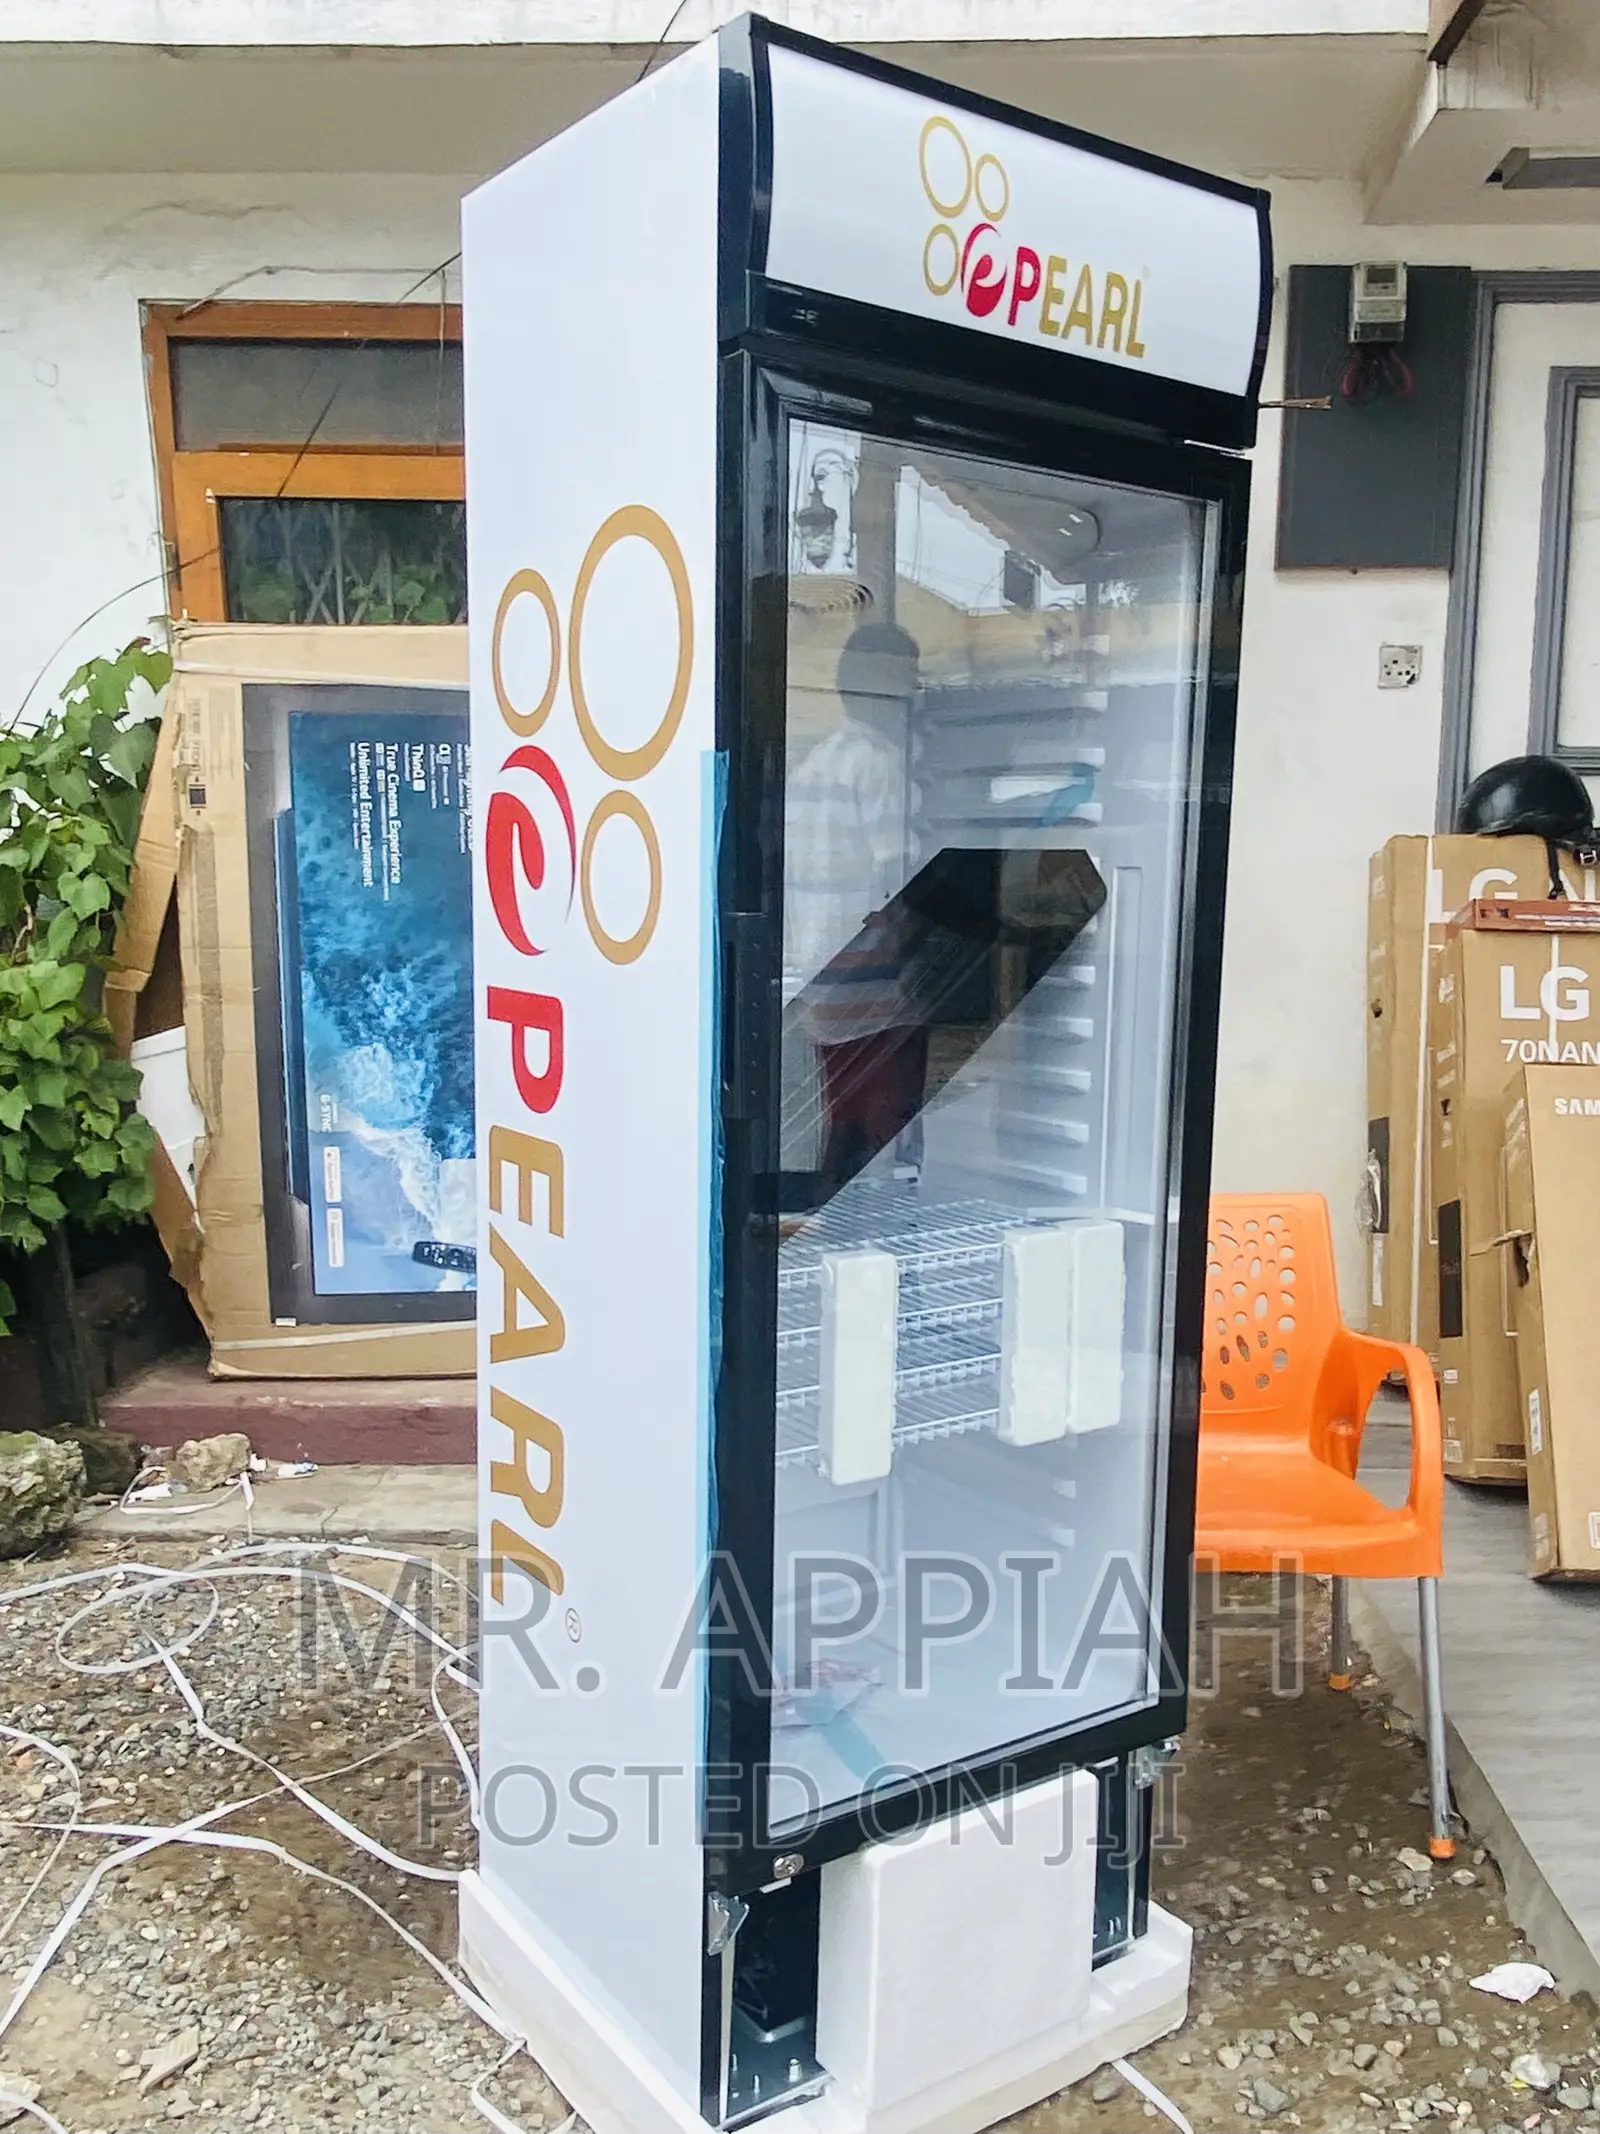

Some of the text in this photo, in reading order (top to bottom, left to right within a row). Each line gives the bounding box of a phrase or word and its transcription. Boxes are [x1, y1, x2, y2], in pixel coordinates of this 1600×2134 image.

[1007, 246, 1146, 358] PEARL
[357, 742, 374, 888] Unlimited Entertainment
[386, 743, 402, 885] True Cinema Experience
[1500, 965, 1590, 1022] LG
[1554, 1098, 1600, 1116] SAM
